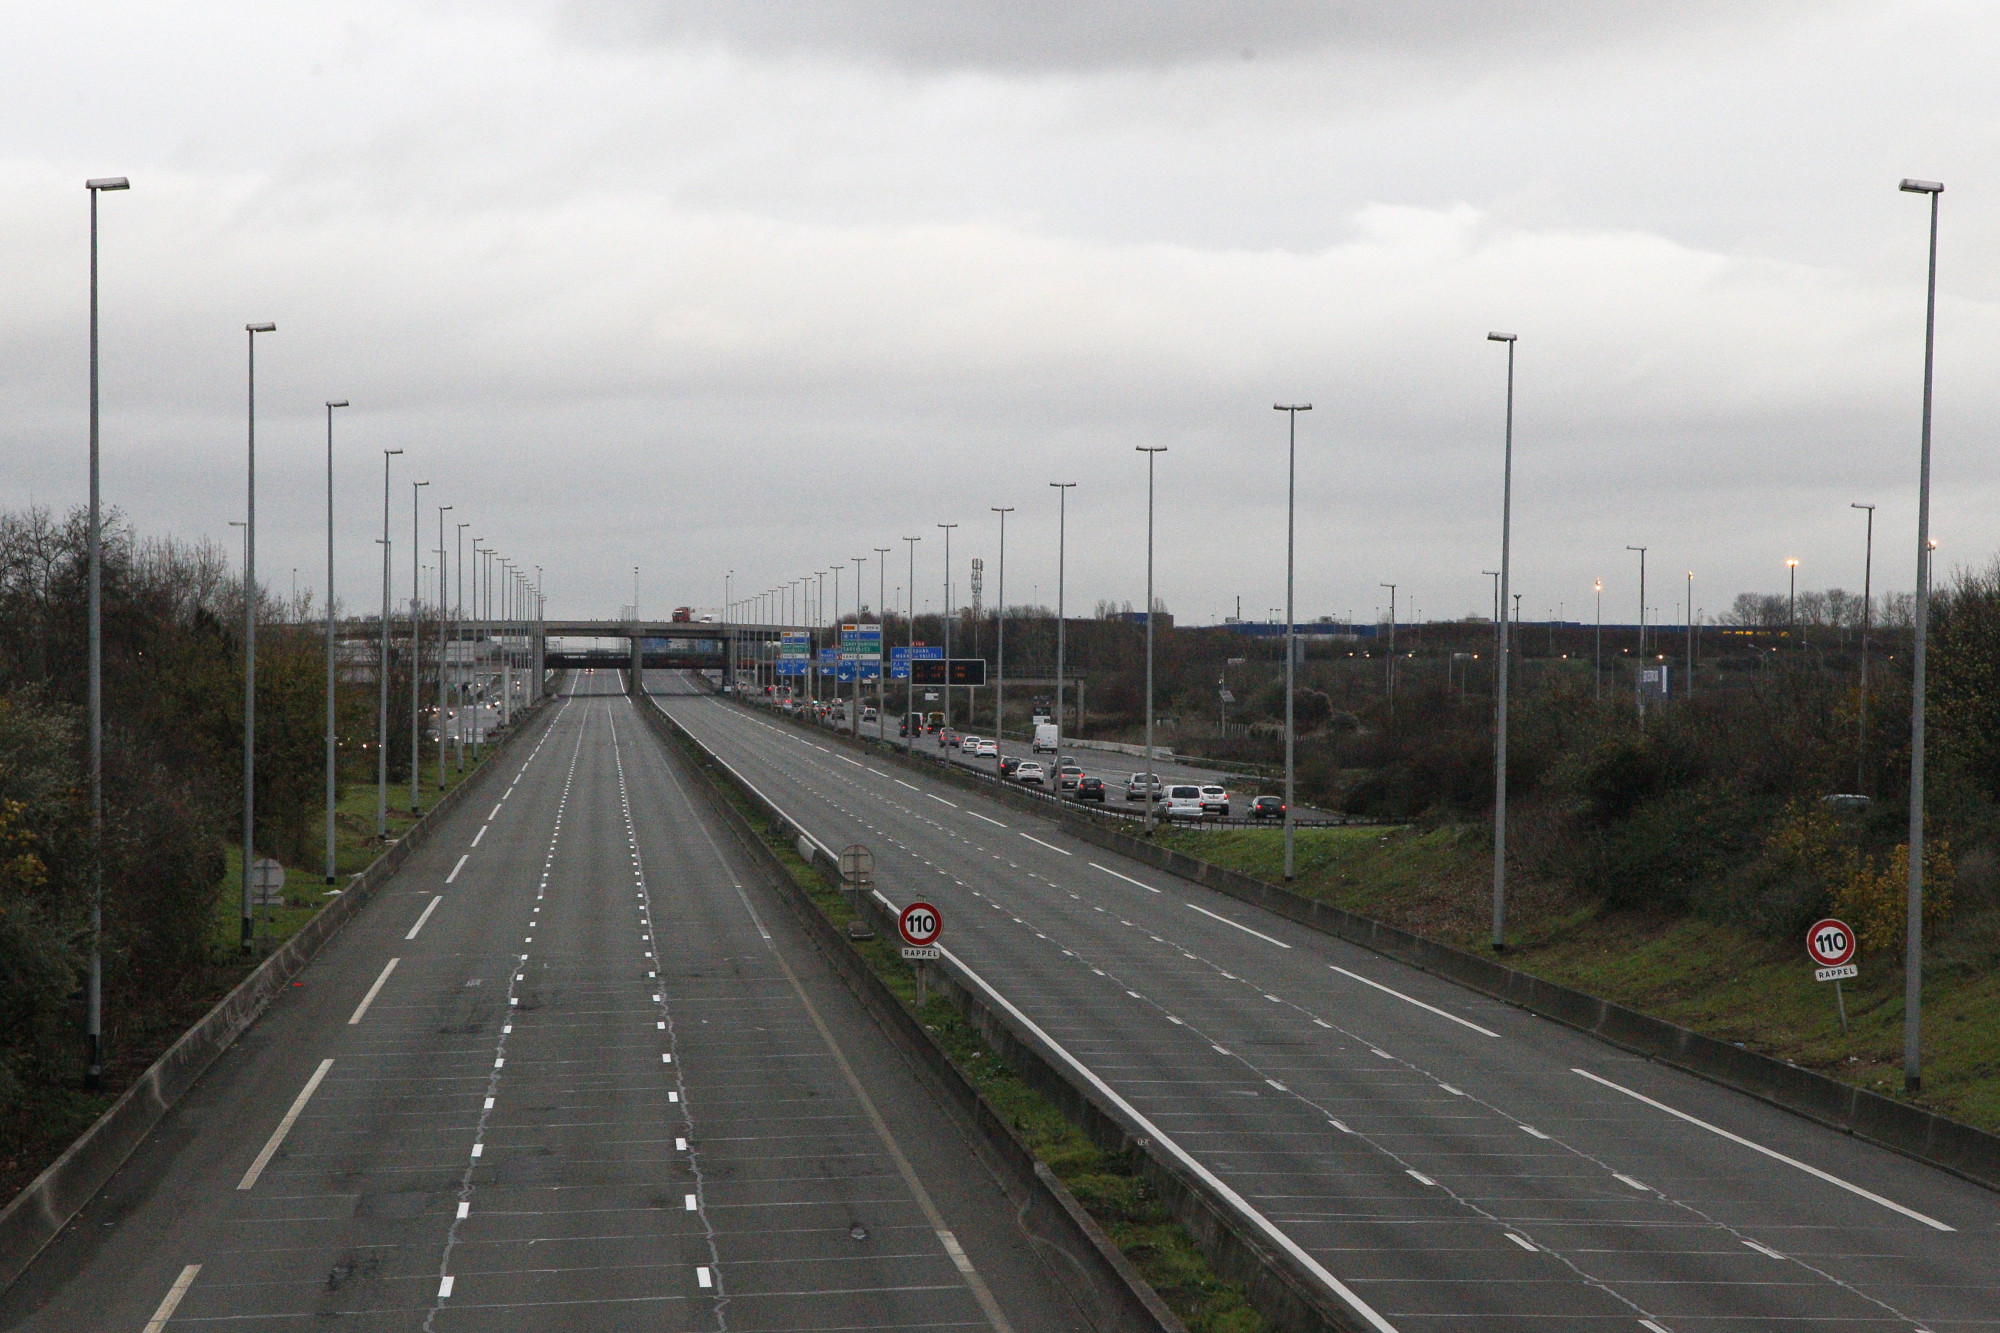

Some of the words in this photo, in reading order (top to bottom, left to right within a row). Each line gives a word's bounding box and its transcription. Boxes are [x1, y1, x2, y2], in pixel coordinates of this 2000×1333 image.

[907, 915, 935, 932] 110
[1816, 932, 1847, 953] 110
[1818, 968, 1855, 978] RAPPEL
